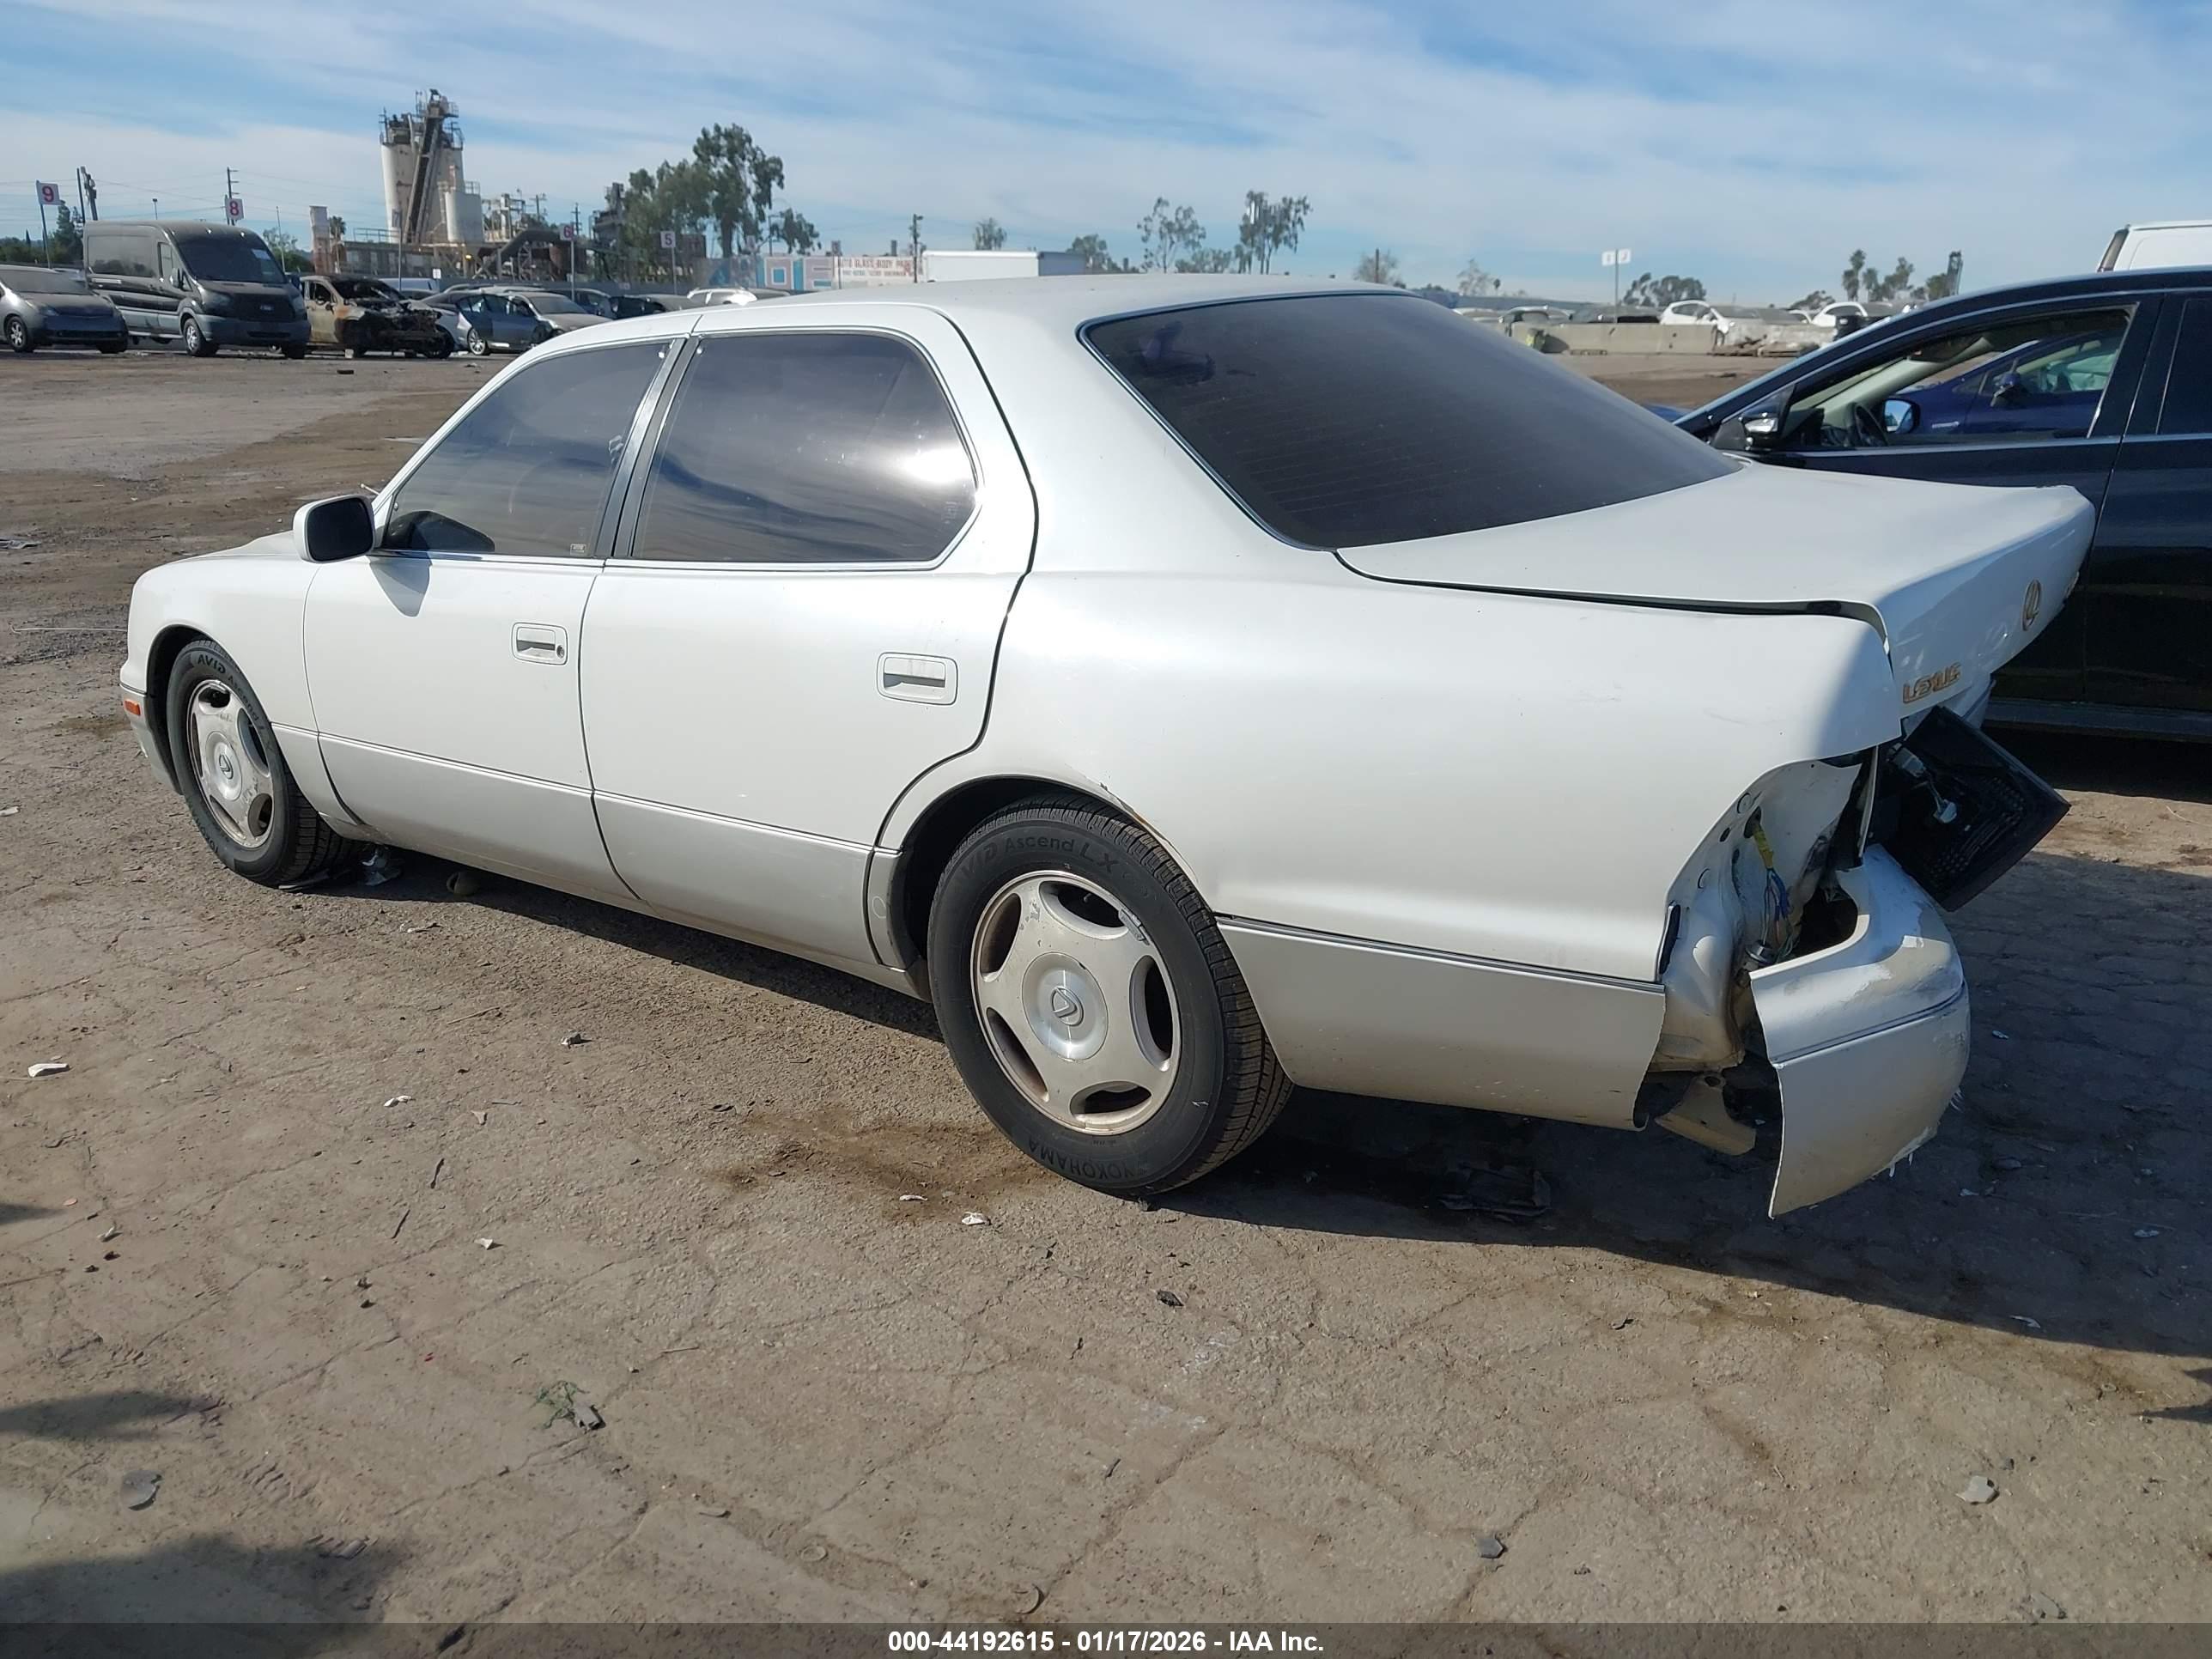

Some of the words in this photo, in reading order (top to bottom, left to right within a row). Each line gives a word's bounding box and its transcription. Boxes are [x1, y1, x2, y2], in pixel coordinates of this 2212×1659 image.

[41, 185, 54, 202] 9
[229, 201, 239, 216] 8
[665, 233, 673, 246] 5
[198, 653, 226, 675] AVID
[1004, 835, 1075, 853] Ascend
[1029, 1139, 1135, 1178] YOKOHAMA
